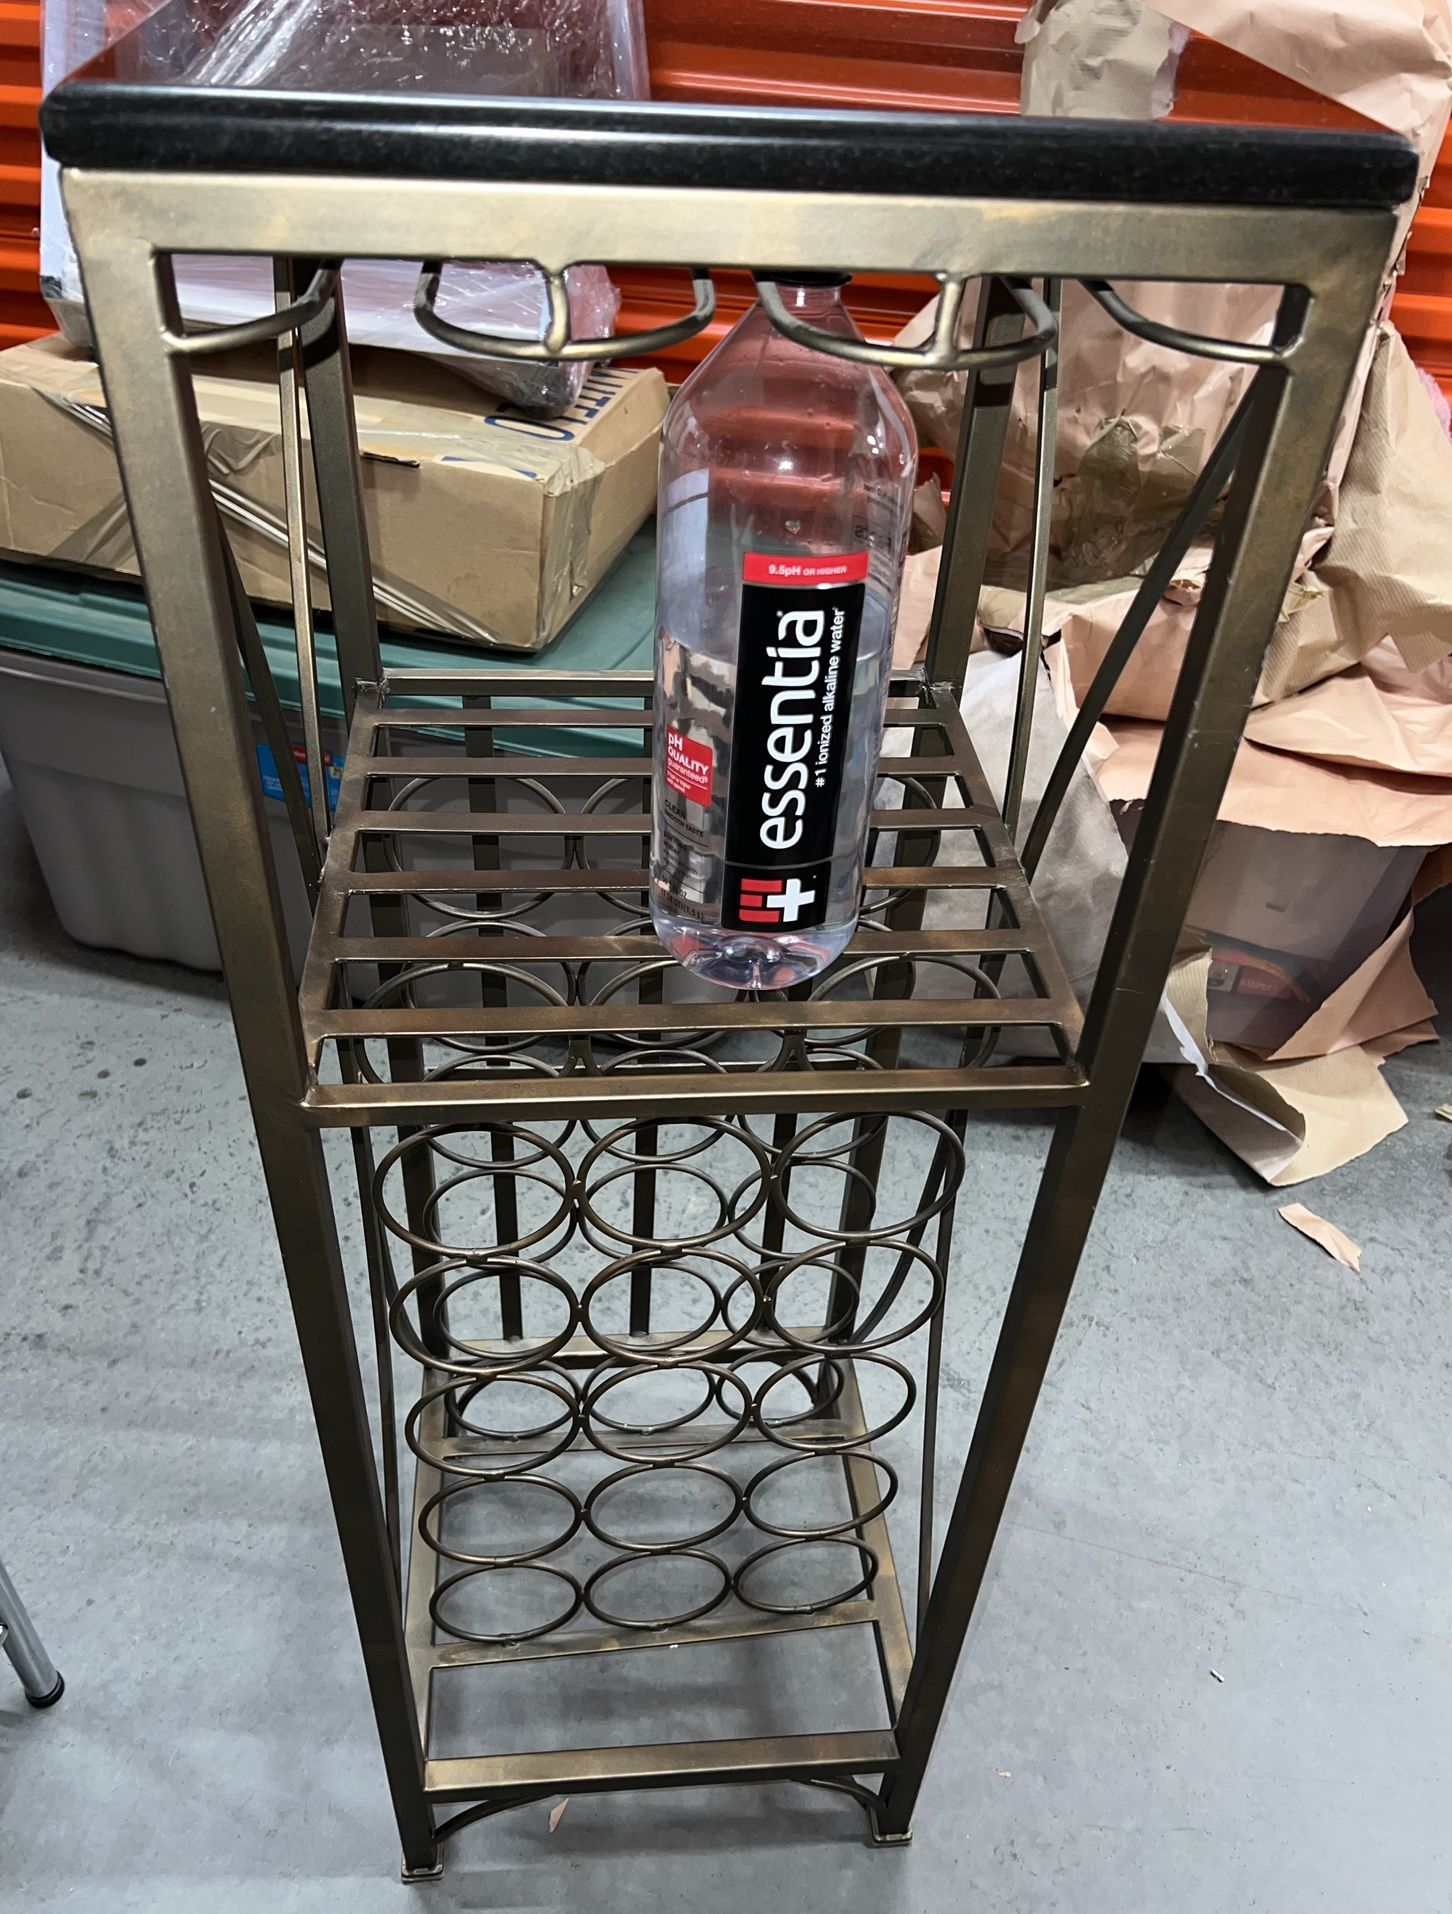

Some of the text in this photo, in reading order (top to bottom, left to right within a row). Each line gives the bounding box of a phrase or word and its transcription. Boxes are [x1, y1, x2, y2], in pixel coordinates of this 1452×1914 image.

[768, 564, 847, 577] 9.5pH OR HIGHER
[814, 609, 845, 788] #1 ionized alkaline water
[668, 732, 683, 751] pH
[760, 610, 825, 849] essentia
[667, 745, 709, 775] QUALITY
